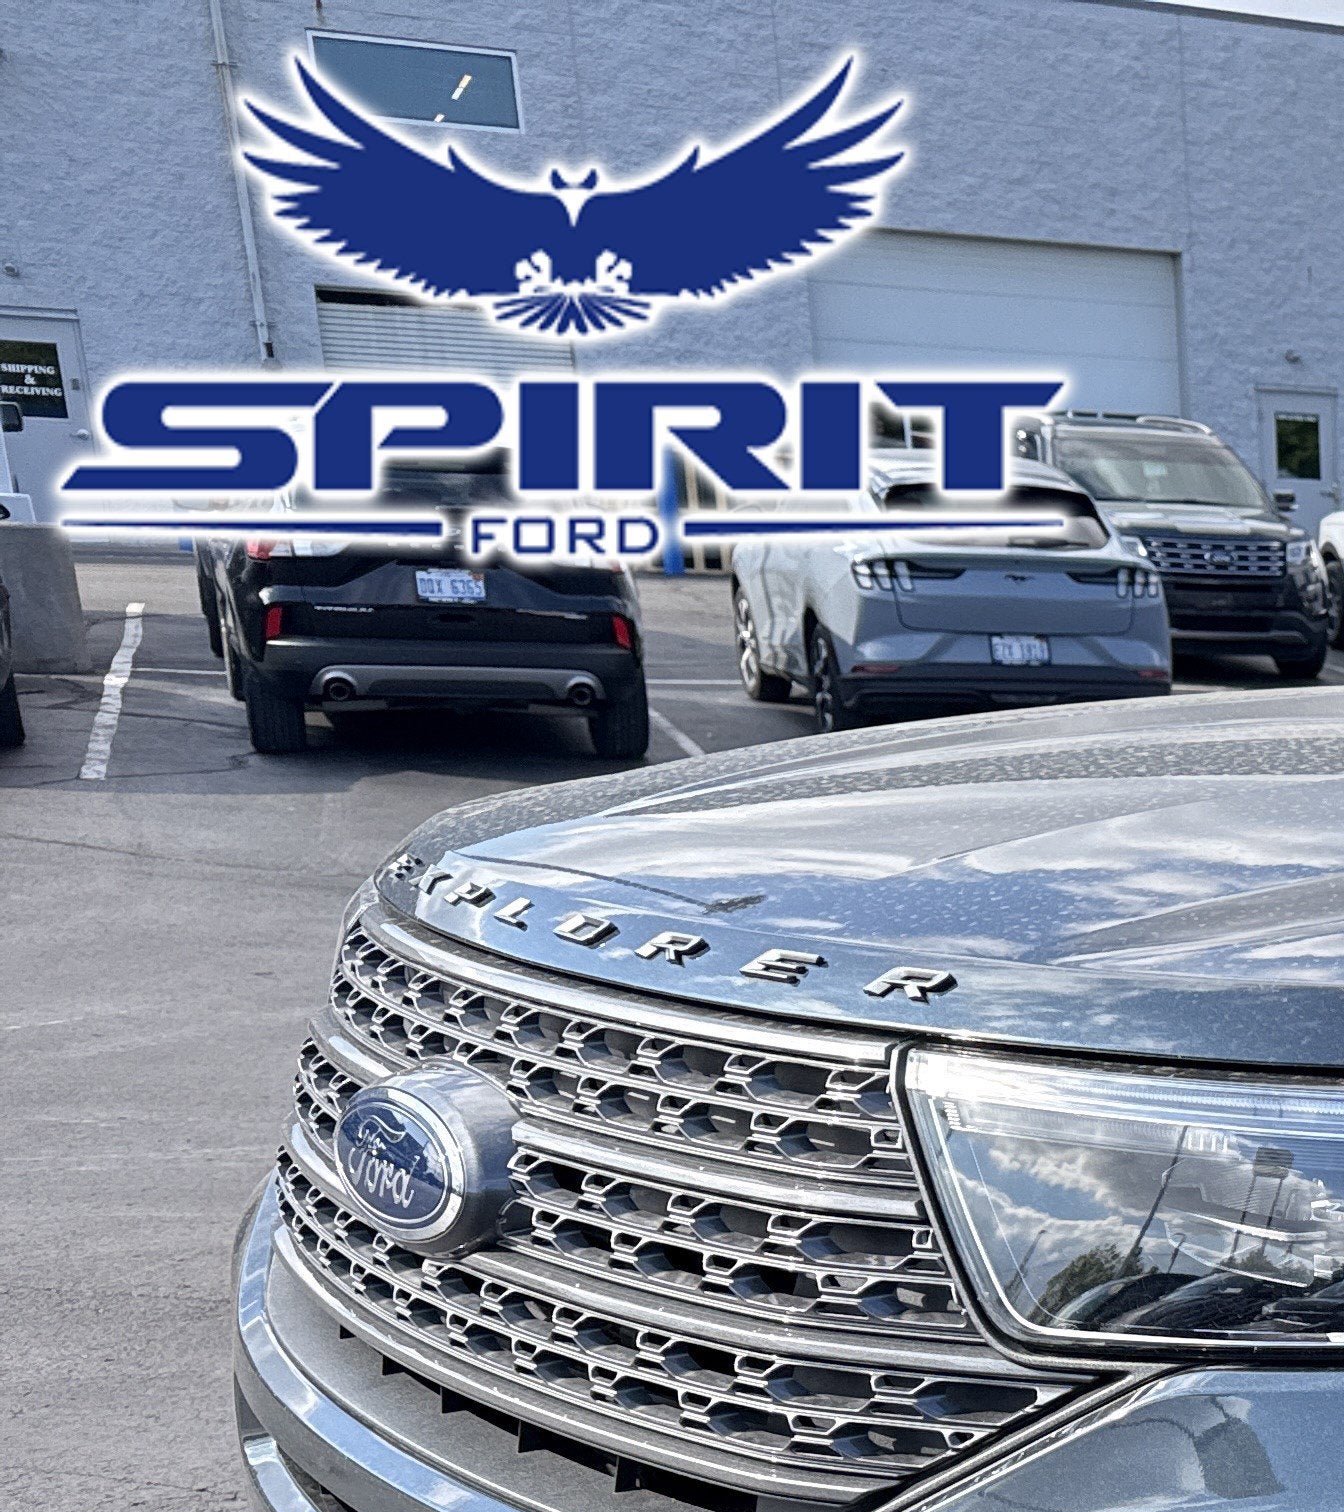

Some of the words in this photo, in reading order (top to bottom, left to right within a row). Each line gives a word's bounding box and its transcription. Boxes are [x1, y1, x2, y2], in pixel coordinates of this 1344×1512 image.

[0, 363, 56, 375] SHIPPING
[24, 373, 36, 385] &
[0, 384, 63, 397] RECEIVING
[388, 853, 959, 1004] EXPLORER
[346, 1113, 423, 1209] Ford
